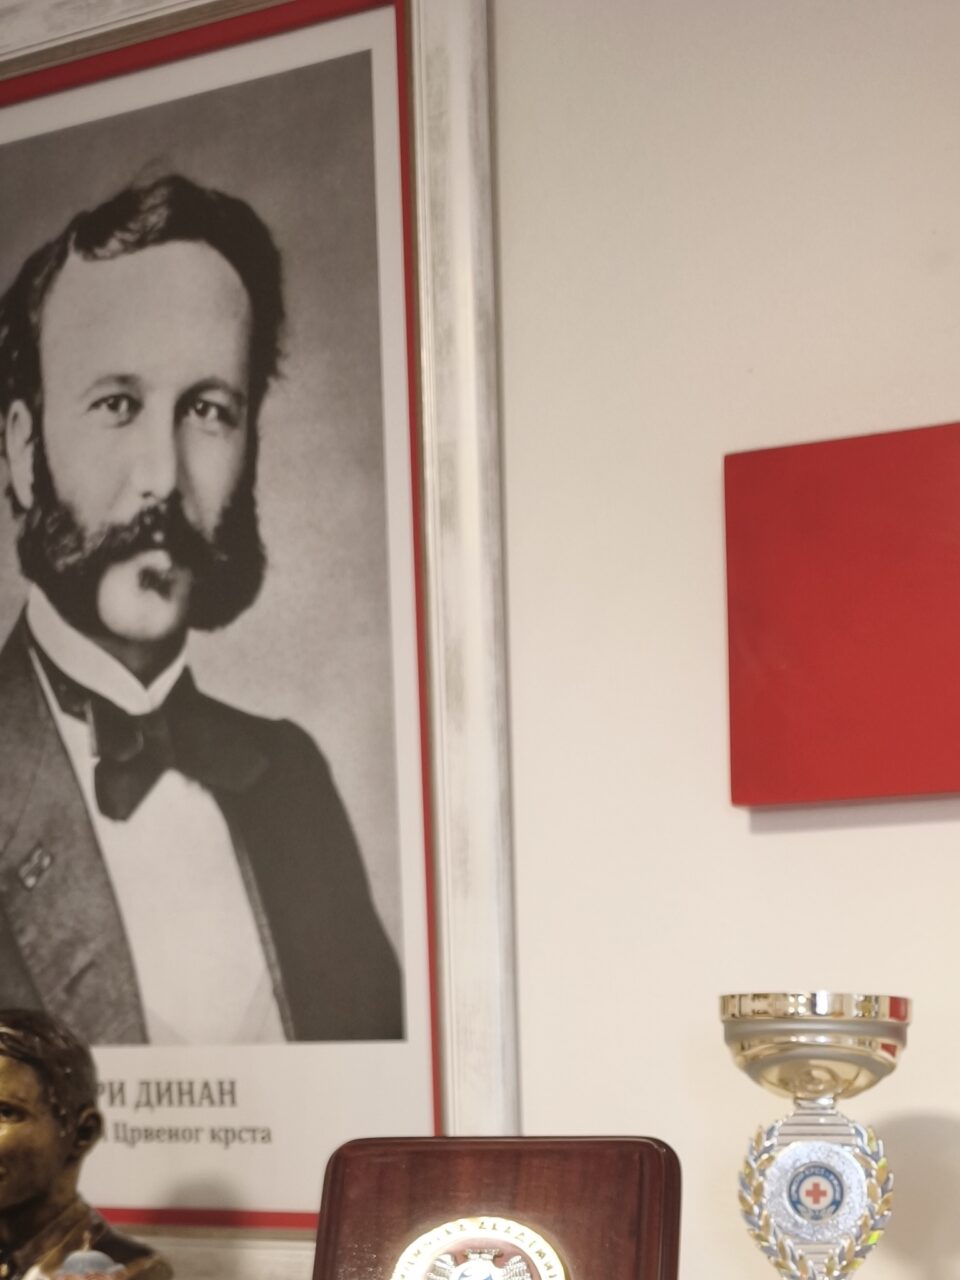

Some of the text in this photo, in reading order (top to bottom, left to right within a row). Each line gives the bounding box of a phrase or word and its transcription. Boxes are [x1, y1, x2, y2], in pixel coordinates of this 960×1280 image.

[134, 1080, 237, 1113] ДИНАН
[113, 1123, 202, 1147] Црвеног
[210, 1127, 272, 1148] крста
